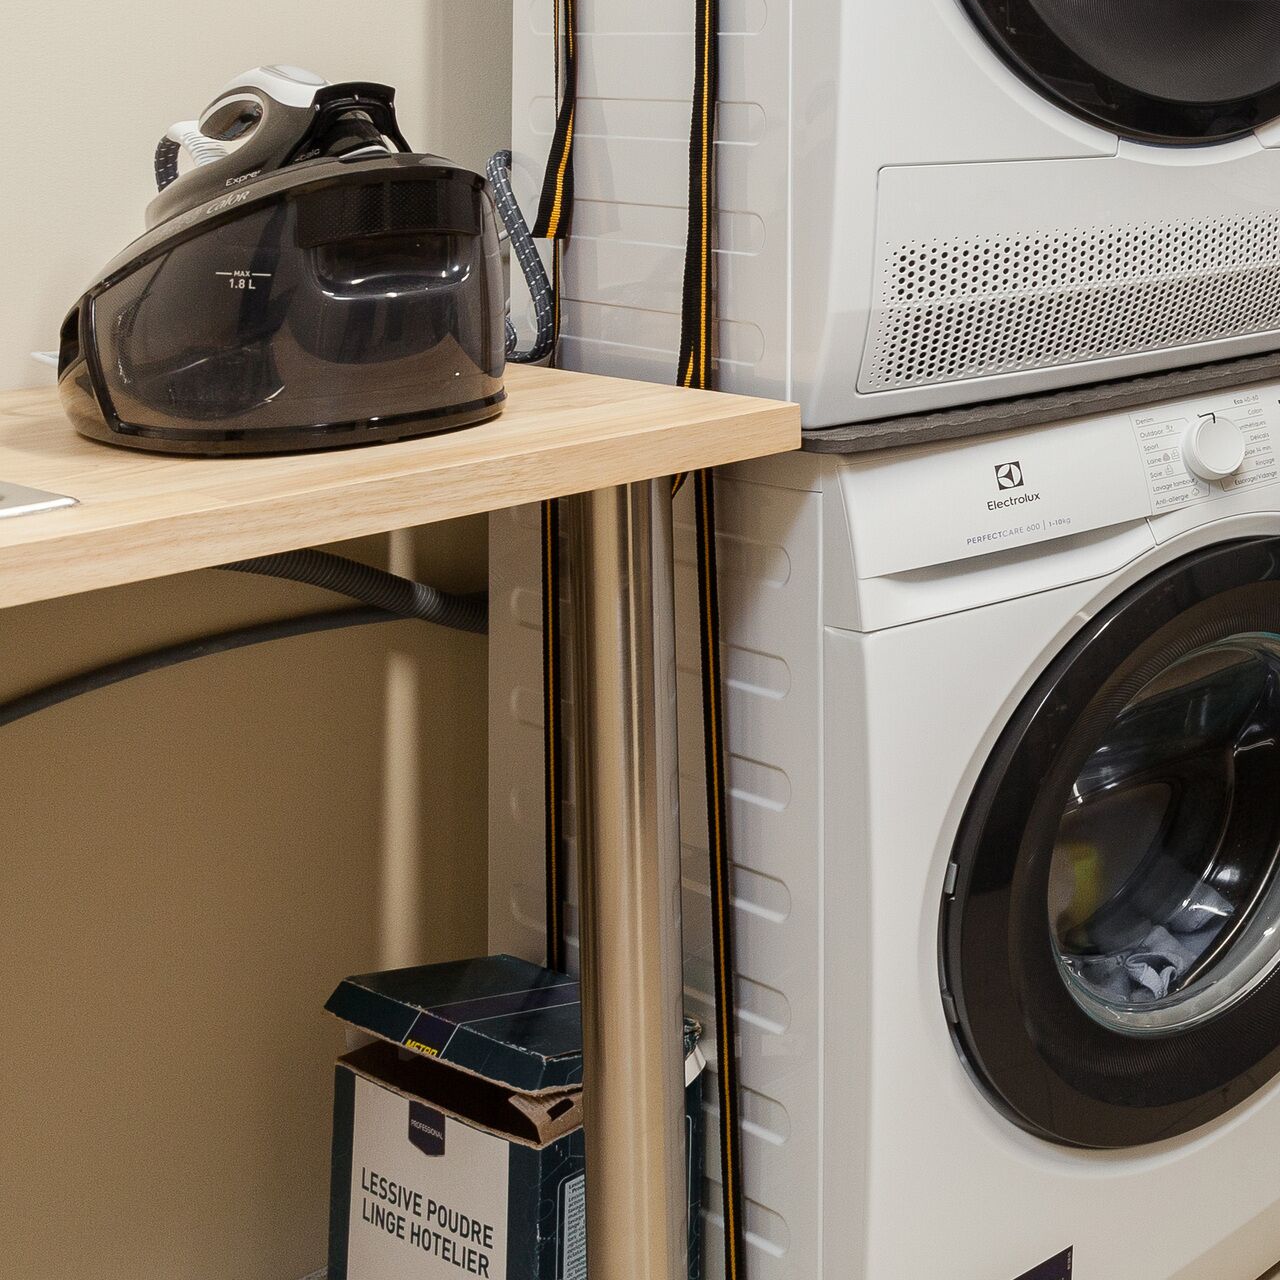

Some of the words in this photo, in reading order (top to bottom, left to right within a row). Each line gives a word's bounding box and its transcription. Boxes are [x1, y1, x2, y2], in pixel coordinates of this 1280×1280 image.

[229, 279, 245, 289] 1.8
[249, 279, 256, 289] L
[1239, 420, 1266, 431] ynthétiques
[987, 492, 1040, 511] Electrolux
[966, 526, 1023, 544] PERFECTCARE
[1026, 523, 1040, 532] 600
[1049, 518, 1071, 527] 1-10kg
[411, 1119, 443, 1140] PROFESSIONAL
[362, 1167, 422, 1217] LESSIVE
[427, 1198, 493, 1249] POUDRE
[363, 1198, 406, 1240] LINGE
[411, 1222, 489, 1279] HOTELIER
